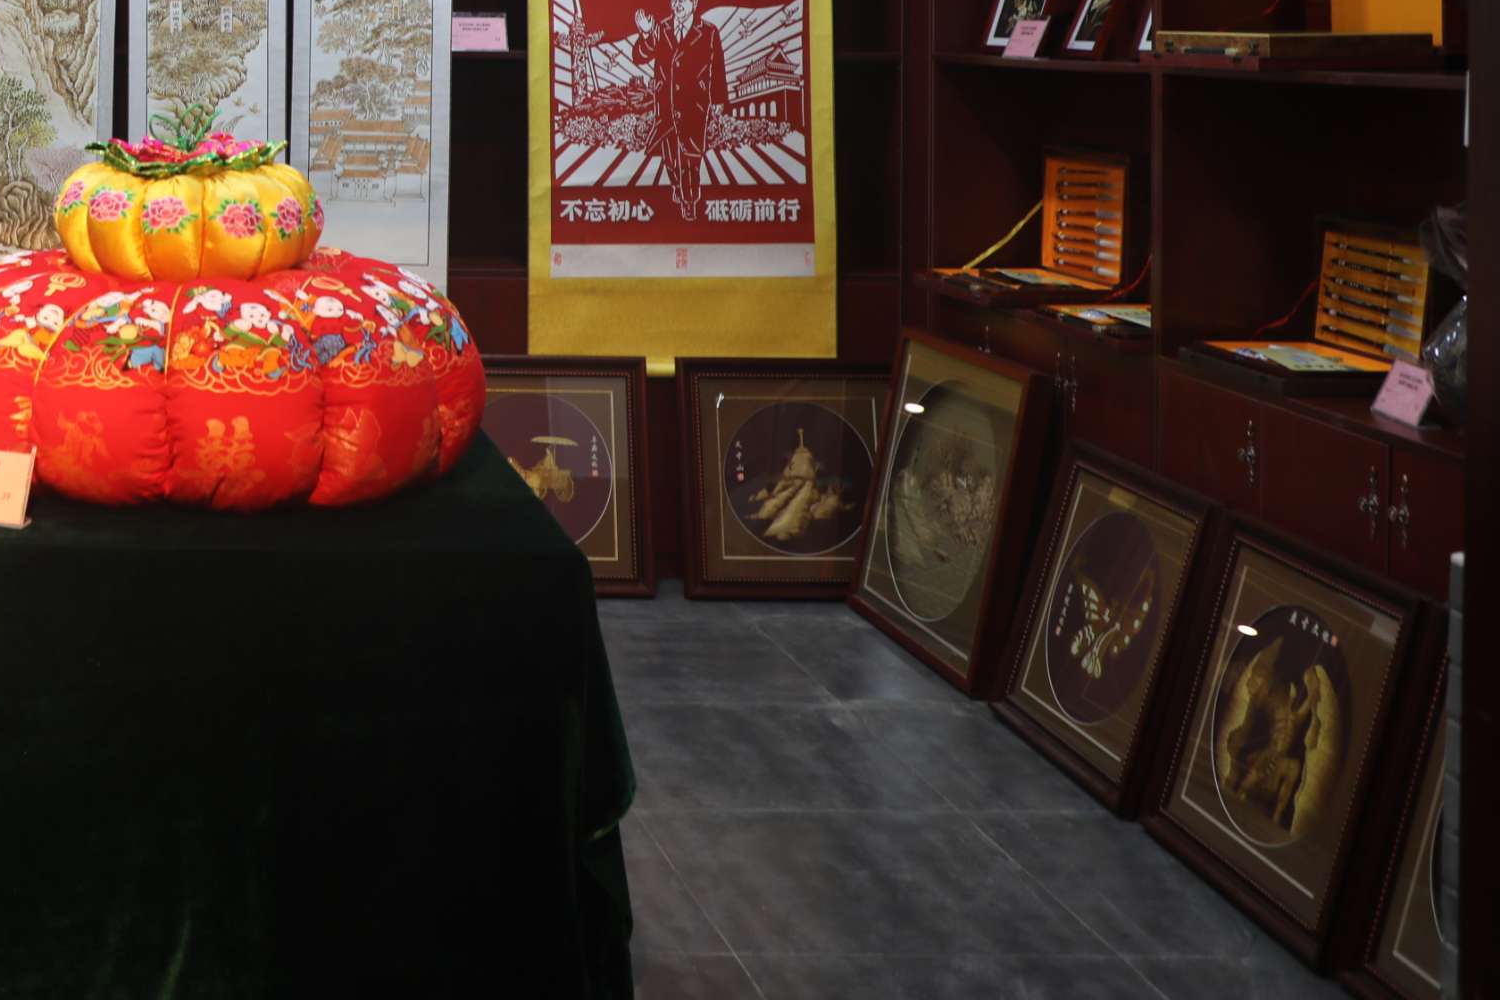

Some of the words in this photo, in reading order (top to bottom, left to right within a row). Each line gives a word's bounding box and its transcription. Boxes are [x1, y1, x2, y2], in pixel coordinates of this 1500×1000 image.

[559, 198, 655, 223] 不忘初心
[704, 198, 802, 223] 砥砺前行
